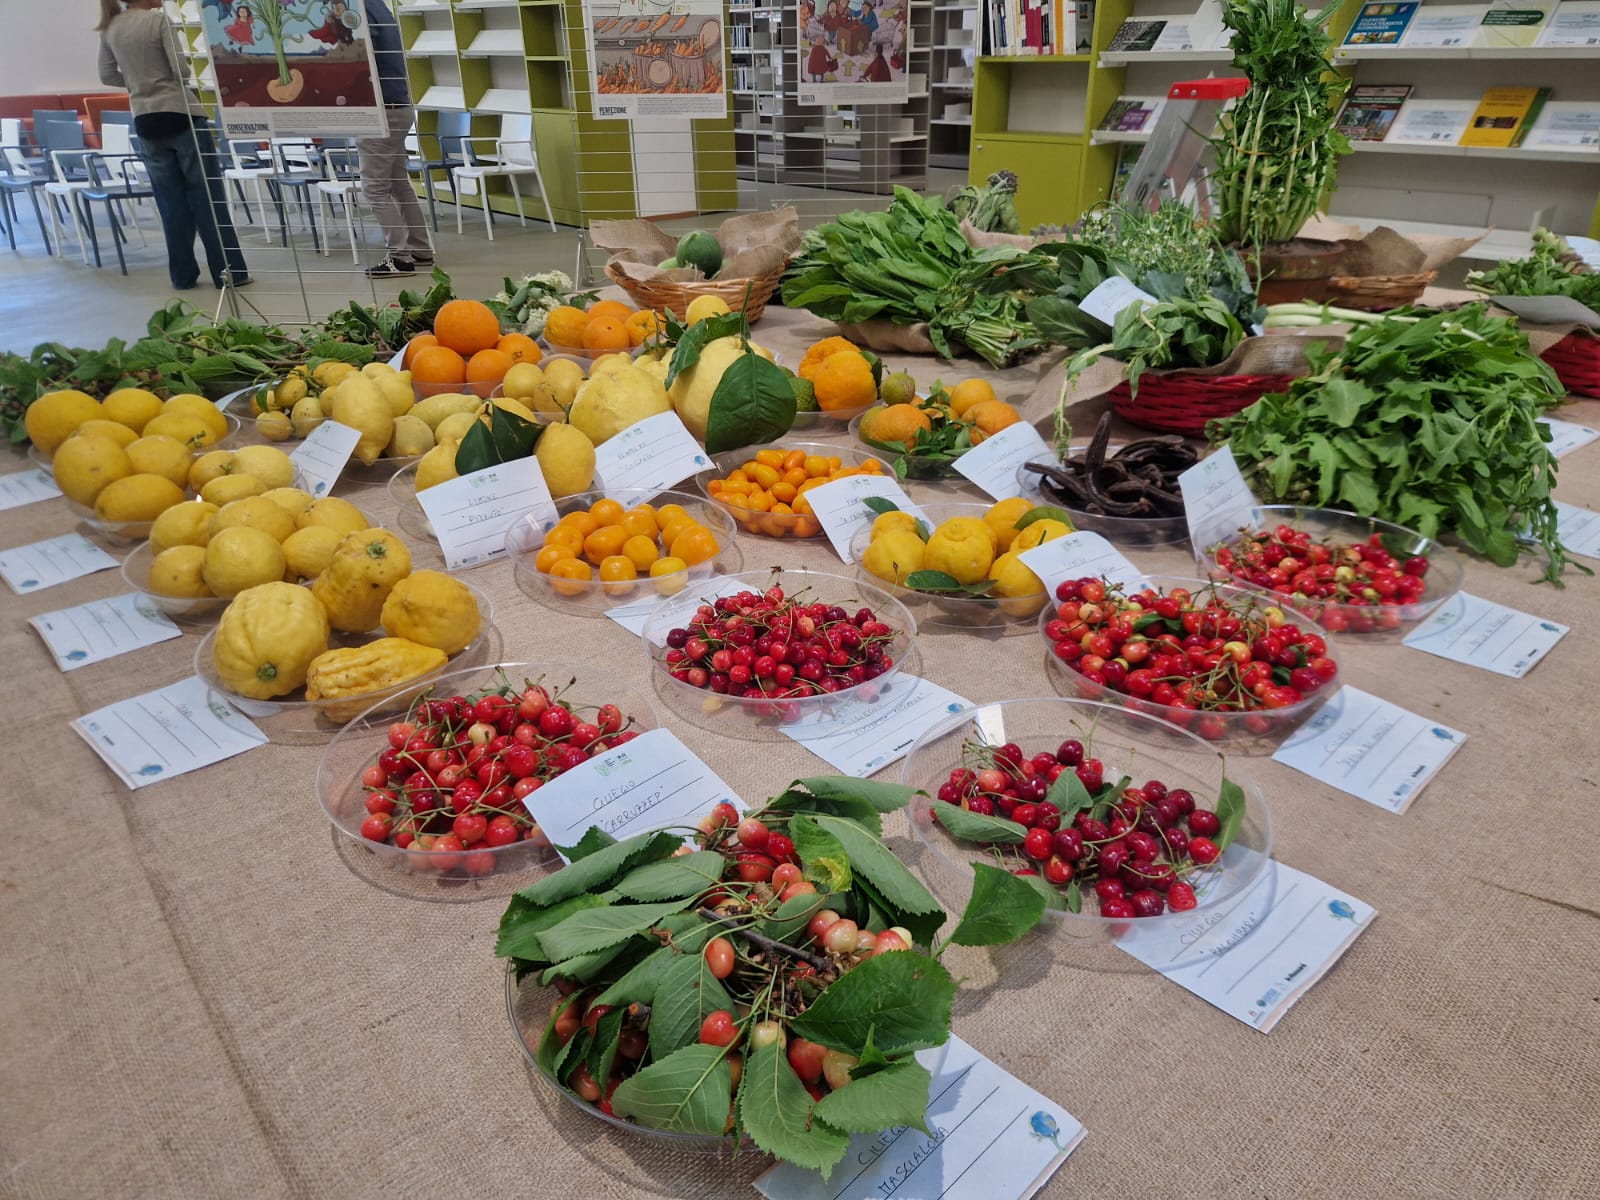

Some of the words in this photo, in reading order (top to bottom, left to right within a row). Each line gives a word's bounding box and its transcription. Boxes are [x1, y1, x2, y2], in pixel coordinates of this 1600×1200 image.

[227, 123, 270, 132] CONSERVAZIONE
[592, 780, 636, 810] CILIEGIO
[857, 1123, 907, 1166] CILIEG
